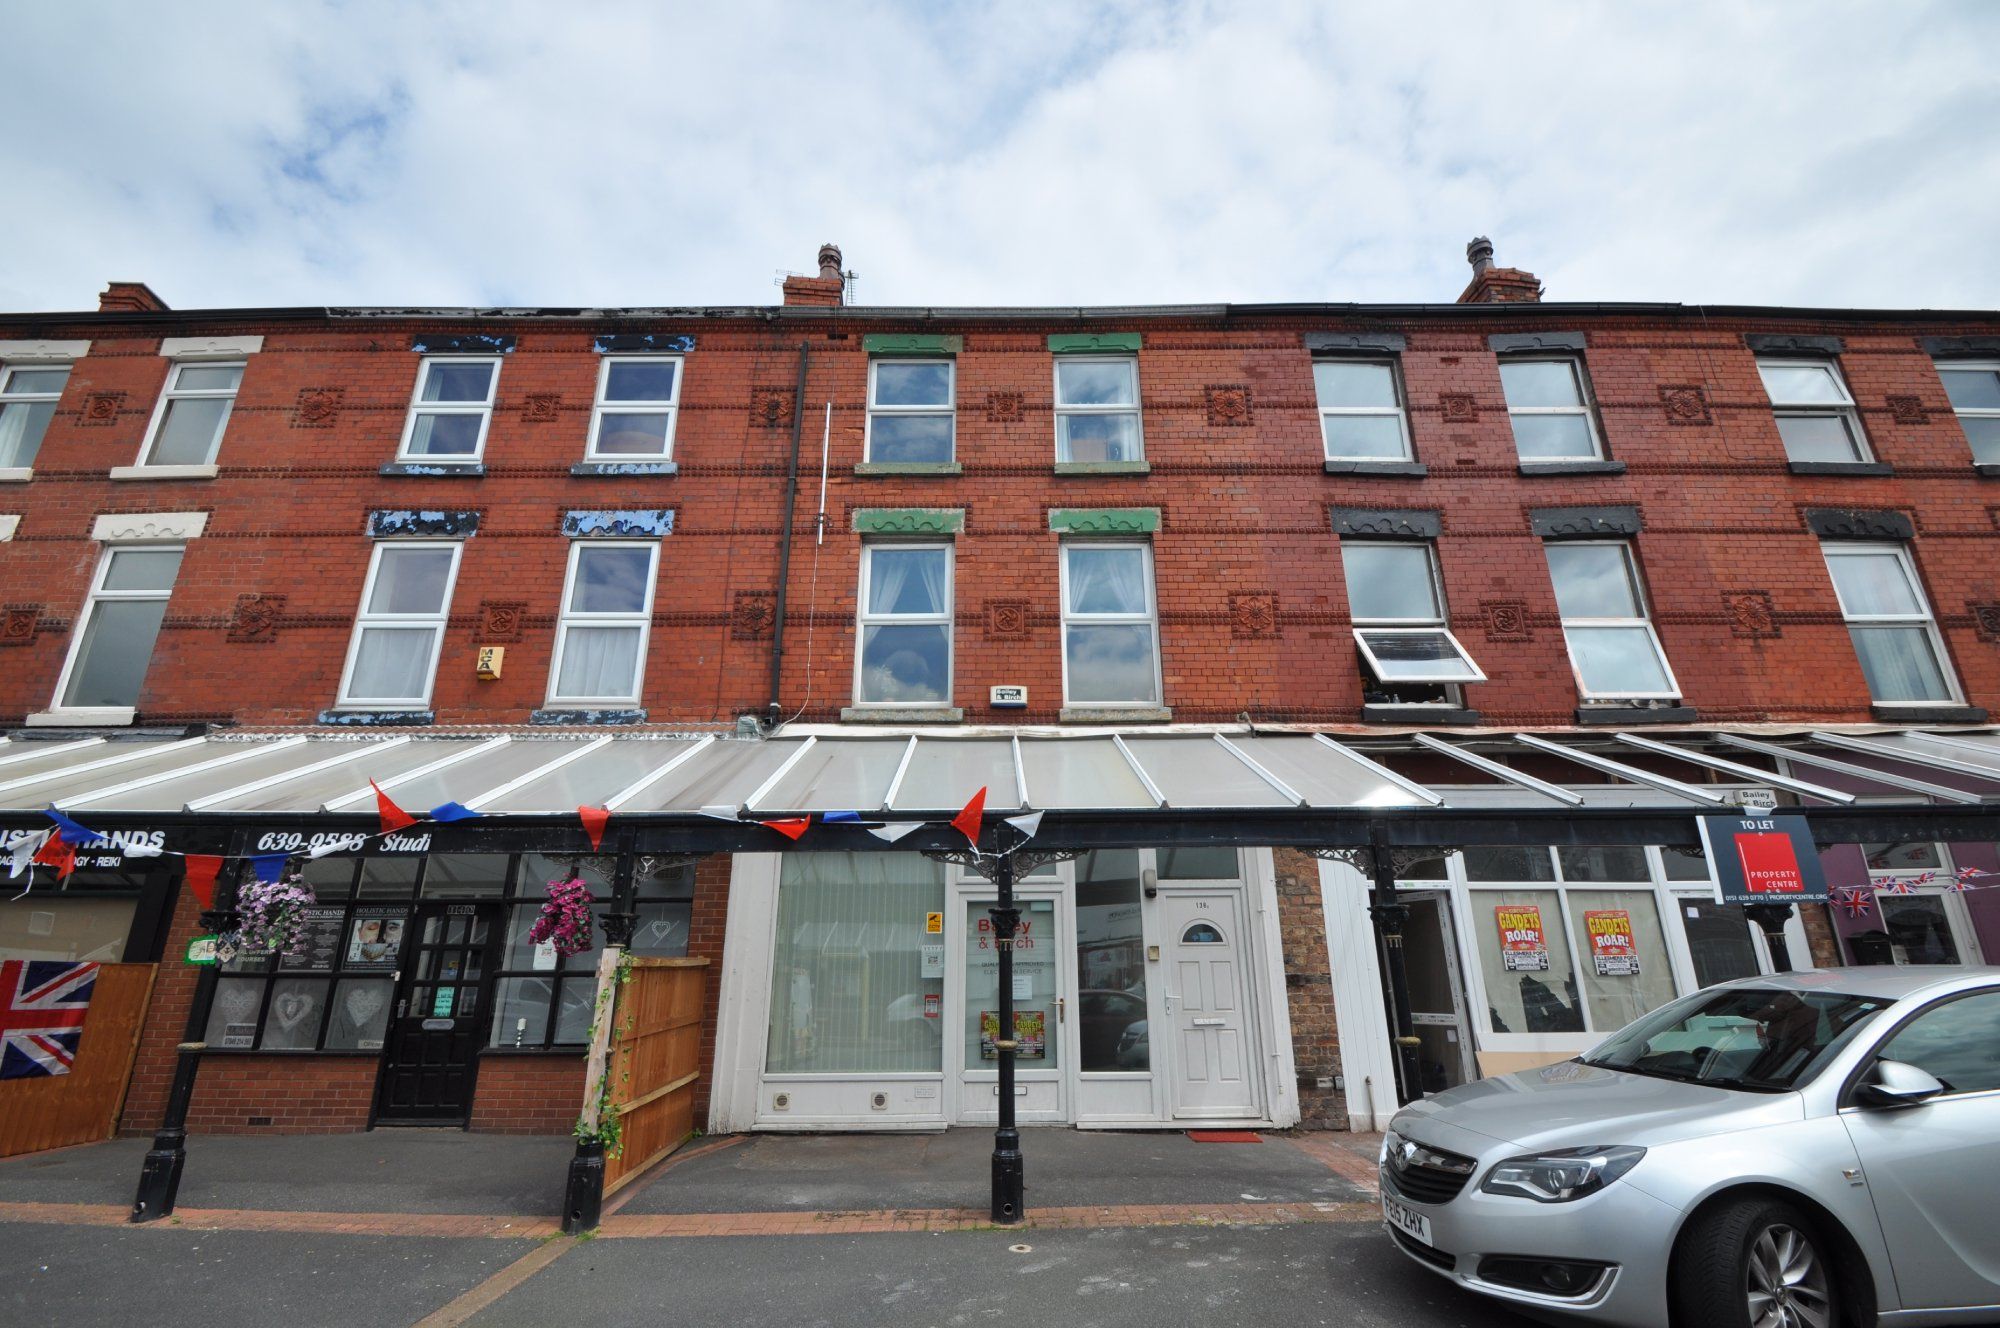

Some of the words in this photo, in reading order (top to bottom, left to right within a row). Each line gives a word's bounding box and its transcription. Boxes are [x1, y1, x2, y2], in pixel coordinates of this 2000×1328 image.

[479, 649, 493, 670] MCA
[1742, 791, 1770, 800] Bailey
[1753, 800, 1776, 808] Birch
[1740, 820, 1755, 829] TO
[1757, 820, 1774, 830] LET
[96, 856, 121, 867] REIKI
[1750, 871, 1796, 879] PROPERTY
[1769, 893, 1828, 901] PROPERTYCENTRE.ORG
[1498, 912, 1540, 930] GANDEYS
[1588, 917, 1631, 935] GANDEYS
[1505, 929, 1539, 943] ROAR!
[1595, 934, 1629, 947] ROAR!
[1402, 1207, 1425, 1238] ZHX
